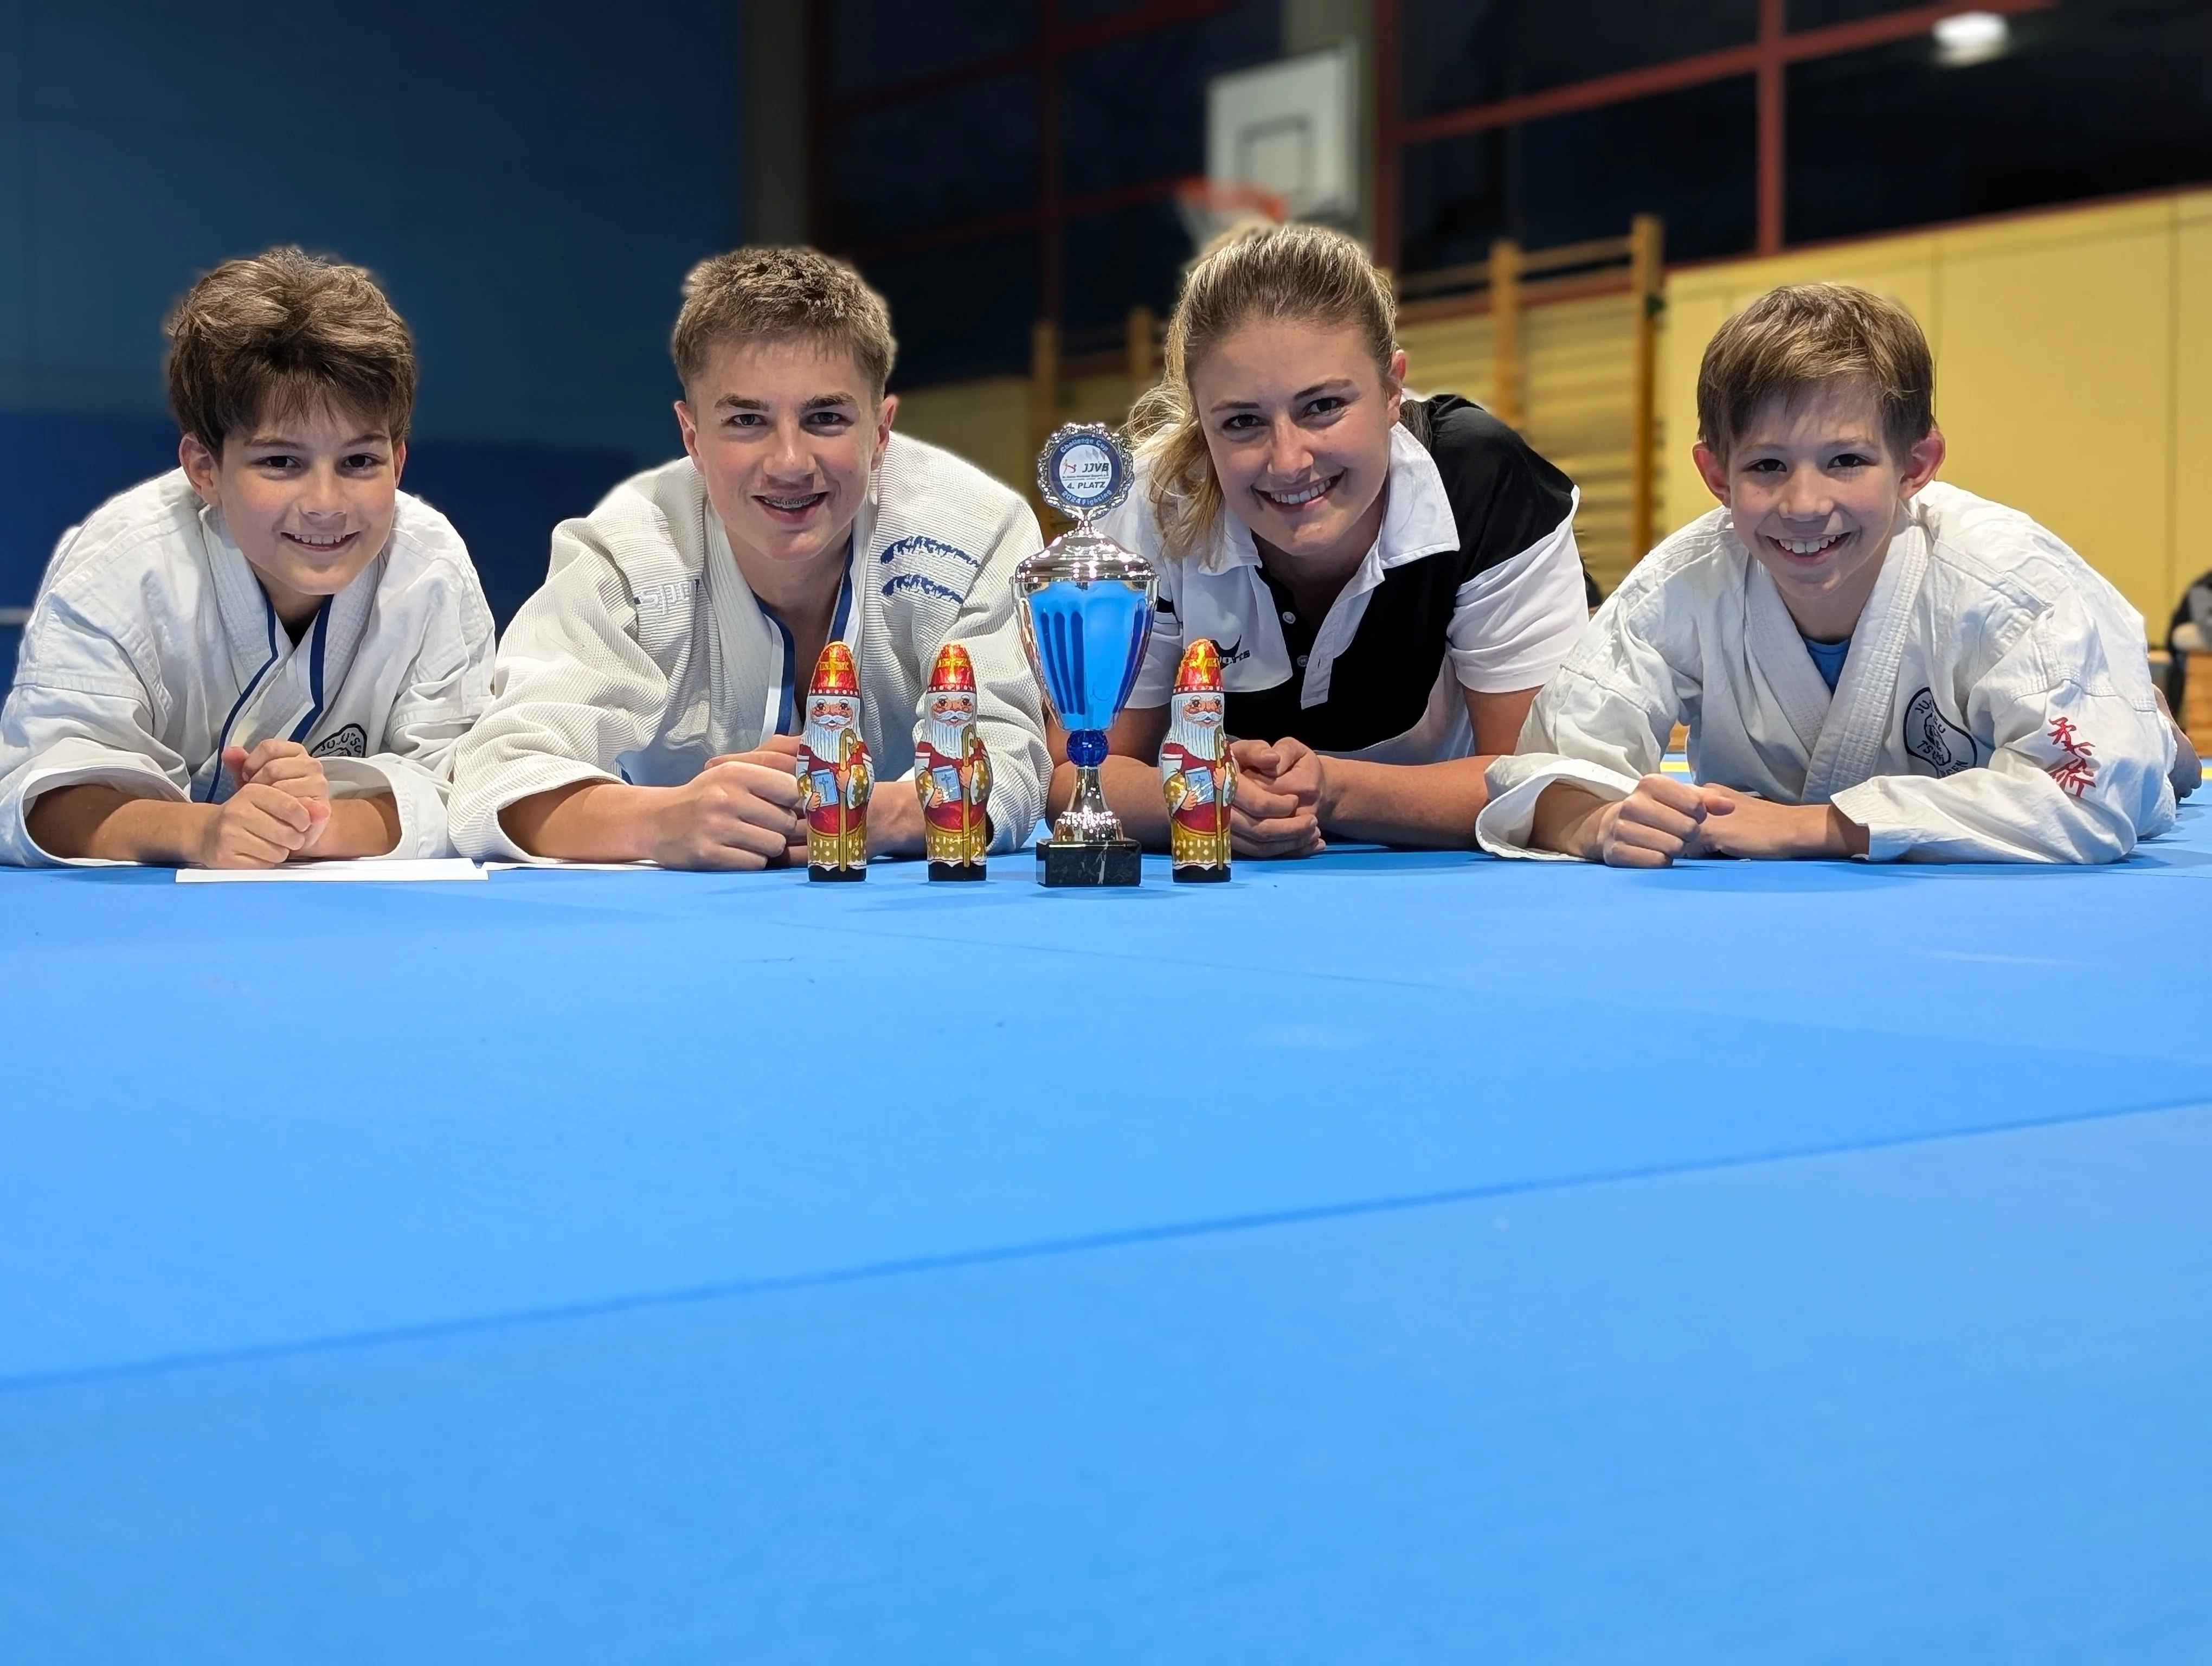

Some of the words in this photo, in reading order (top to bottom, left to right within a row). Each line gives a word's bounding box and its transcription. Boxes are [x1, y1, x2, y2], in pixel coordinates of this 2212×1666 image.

[1060, 438, 1094, 453] Challenge
[1096, 440, 1109, 452] Cup
[1082, 463, 1109, 473] JJVB
